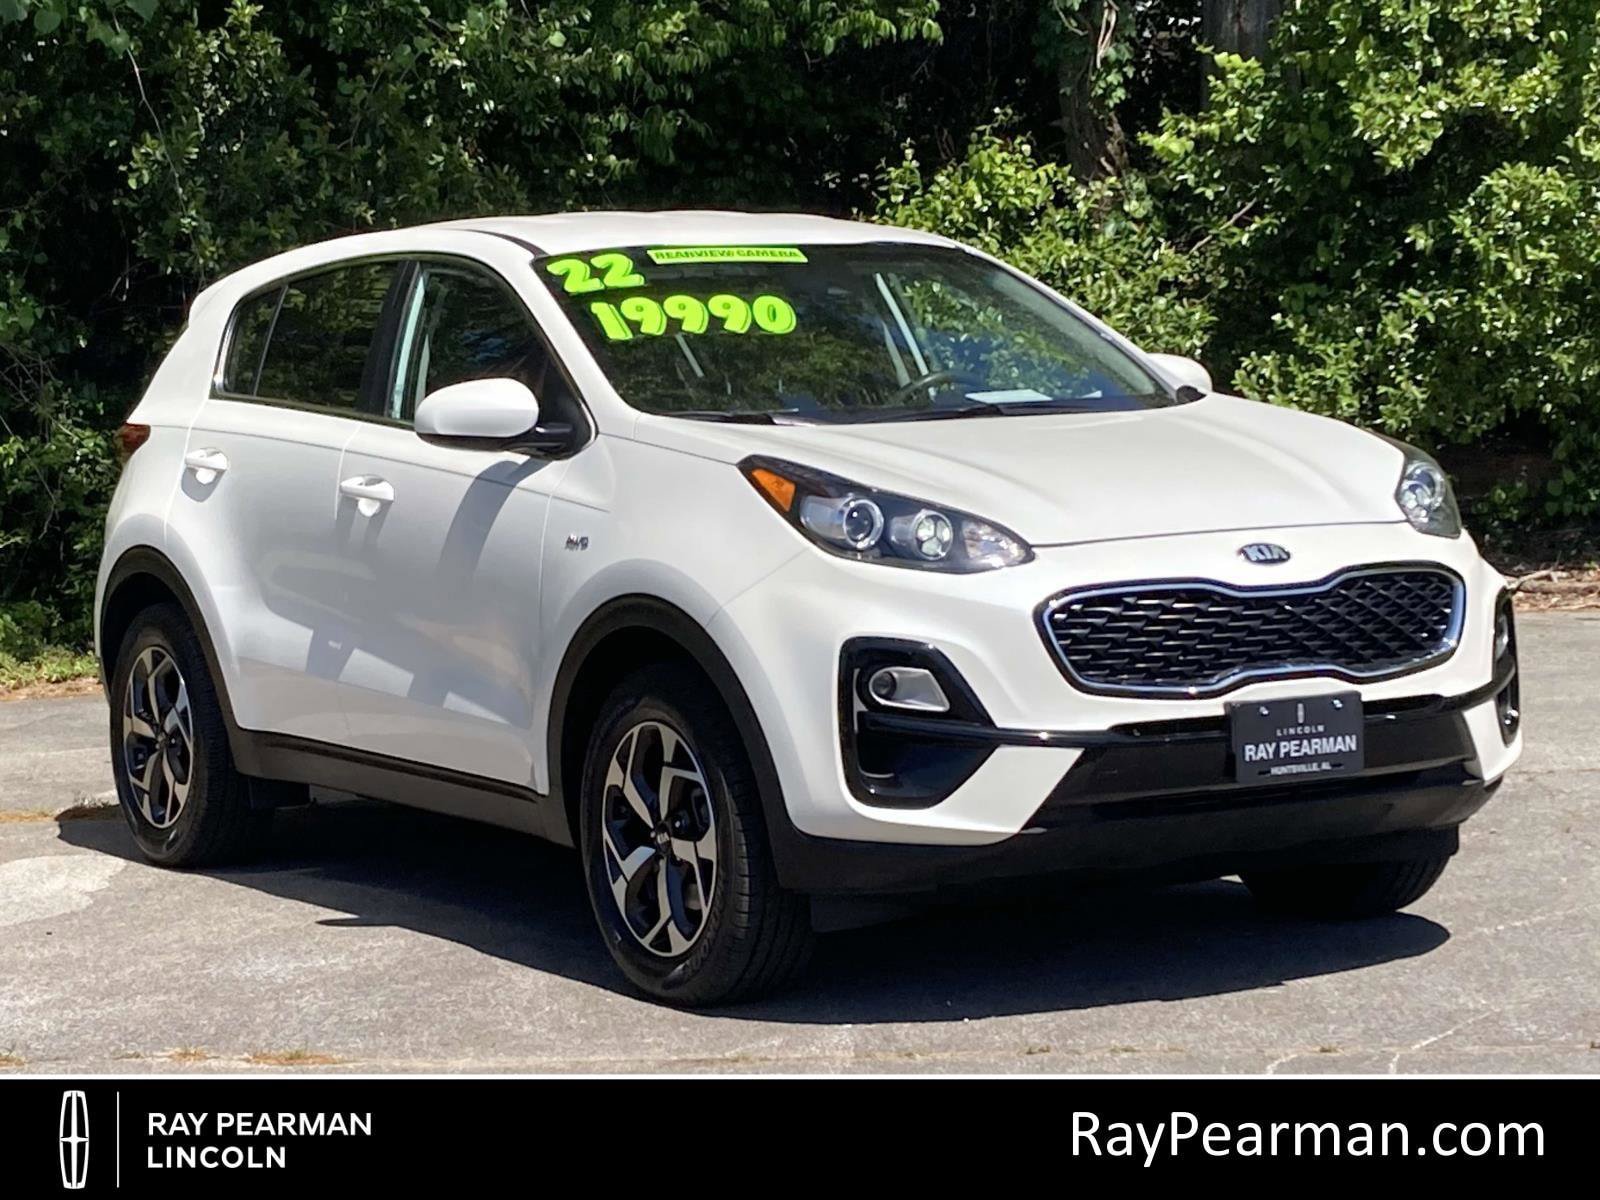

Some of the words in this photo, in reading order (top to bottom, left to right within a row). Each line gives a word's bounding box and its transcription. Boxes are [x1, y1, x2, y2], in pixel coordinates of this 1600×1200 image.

[736, 249, 800, 258] CAMERA
[546, 253, 645, 294] 22
[590, 294, 798, 341] 19990
[1243, 545, 1289, 561] KIA
[1276, 725, 1325, 736] LINCOLN
[1244, 742, 1276, 762] RAY
[1279, 735, 1357, 759] PEARMAN
